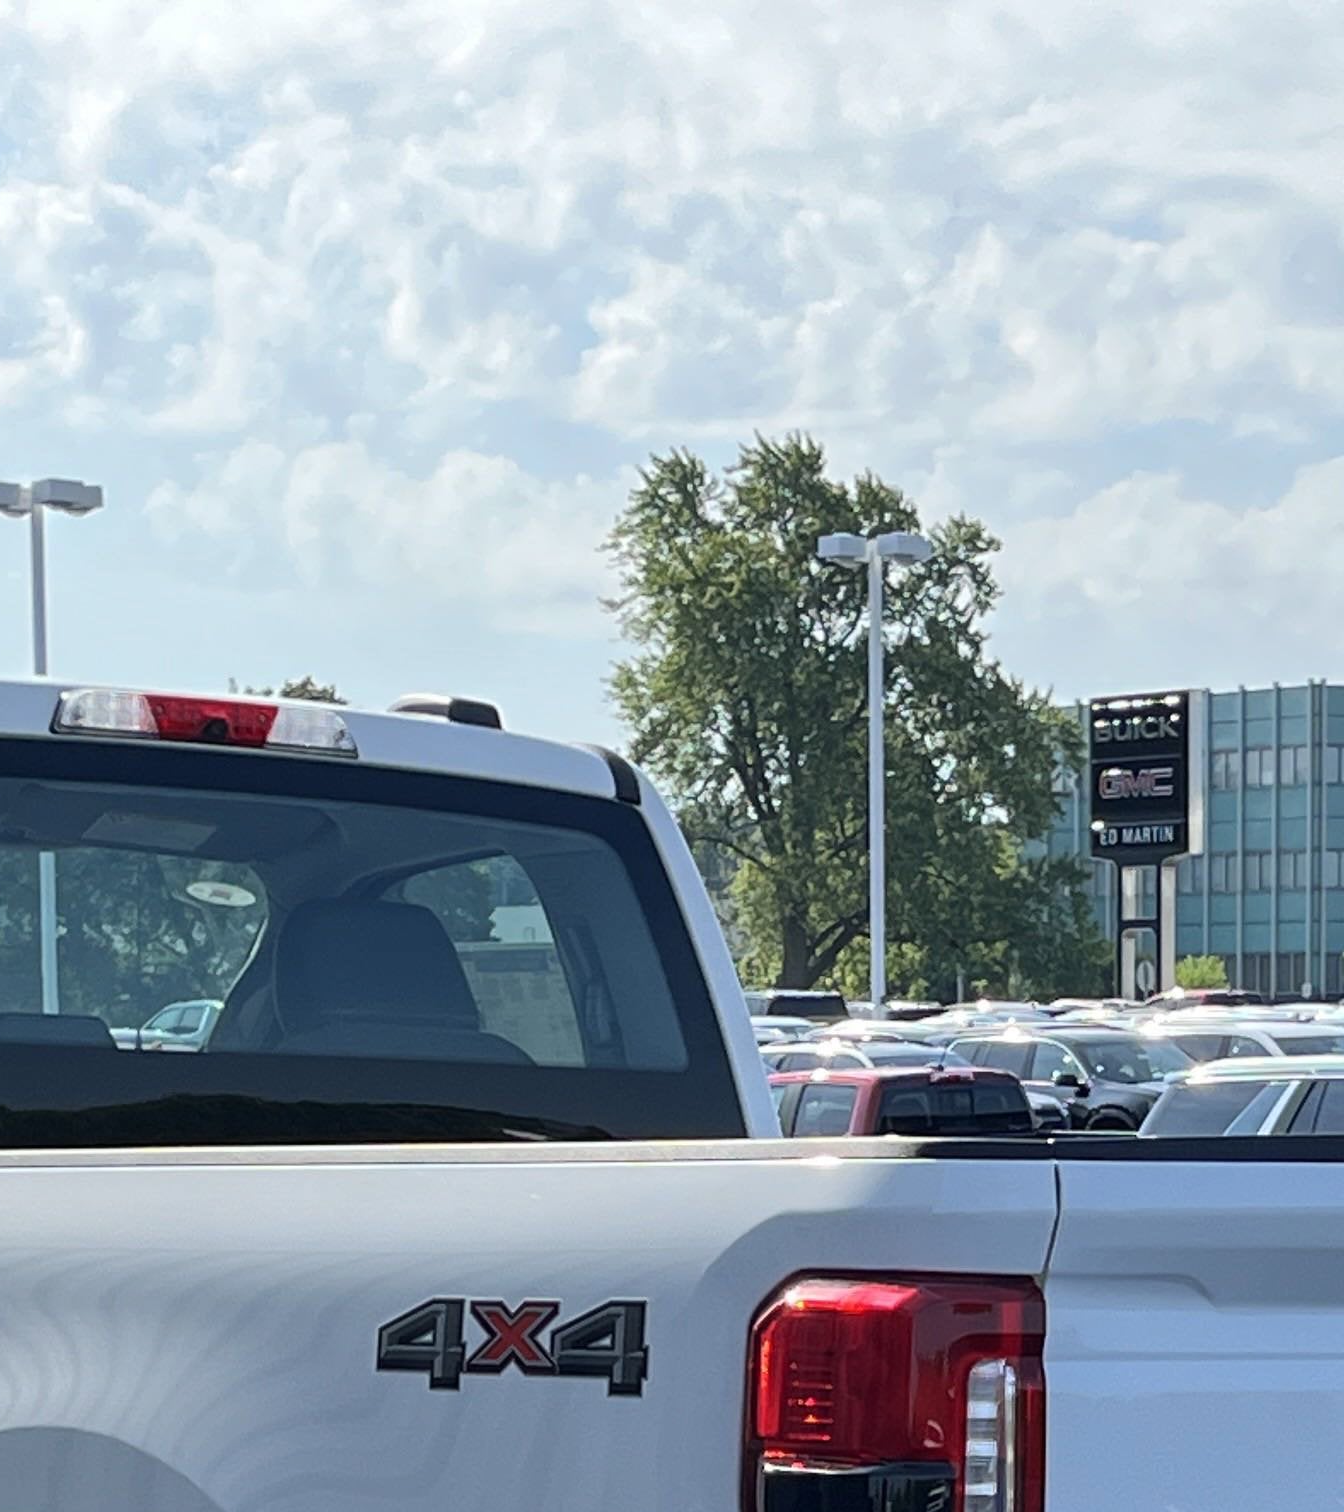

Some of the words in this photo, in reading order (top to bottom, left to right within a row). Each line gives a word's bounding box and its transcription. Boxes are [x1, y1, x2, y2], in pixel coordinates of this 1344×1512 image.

[1094, 714, 1180, 744] BUICK
[1099, 767, 1174, 799] GMC
[1100, 828, 1118, 846] ED
[1122, 825, 1175, 844] MARTIN
